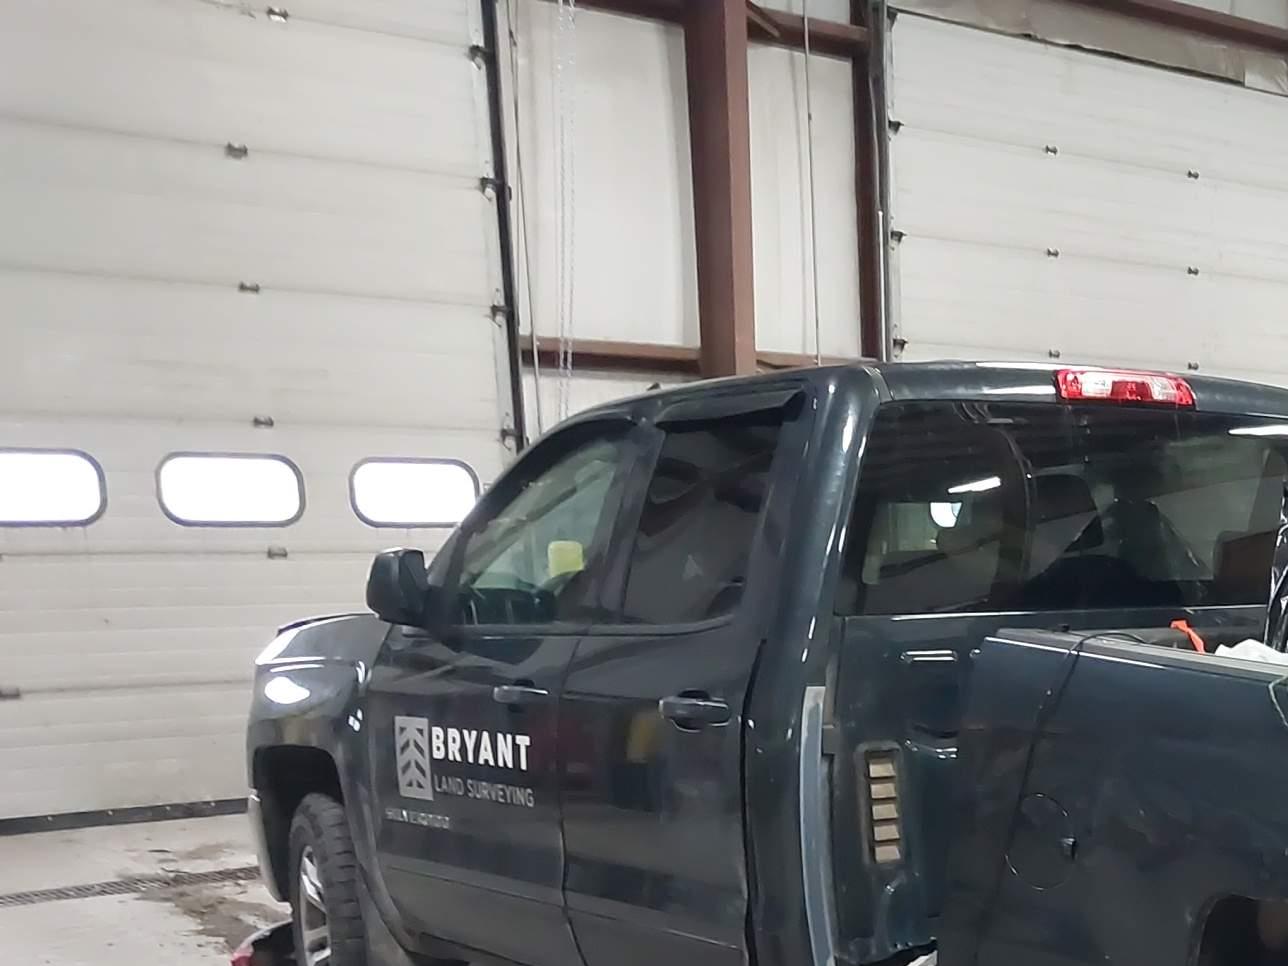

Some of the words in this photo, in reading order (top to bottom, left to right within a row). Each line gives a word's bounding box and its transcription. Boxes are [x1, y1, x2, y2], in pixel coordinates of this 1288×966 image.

[431, 726, 531, 771] BRYANT
[433, 775, 465, 796] LAND
[467, 779, 535, 808] SURVEYING
